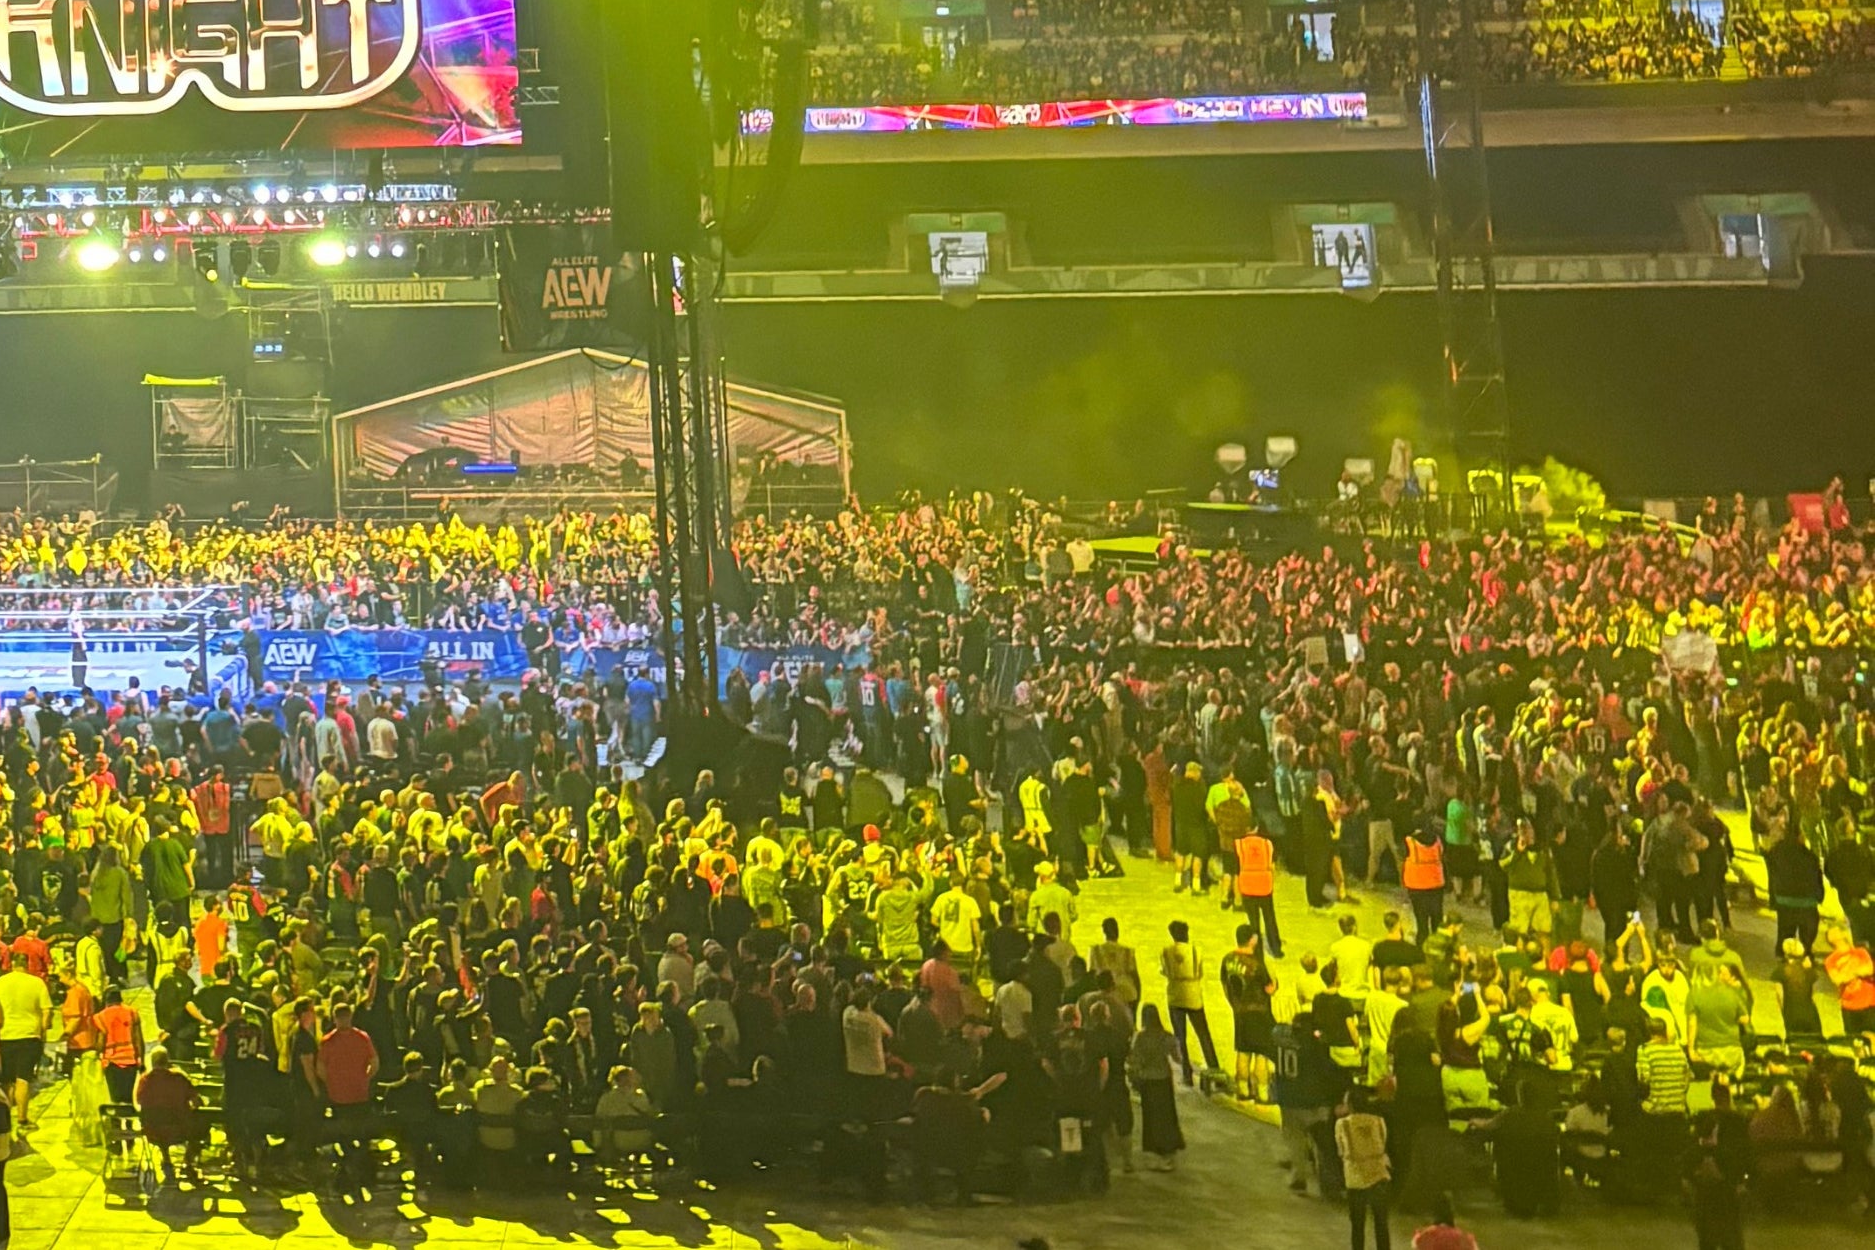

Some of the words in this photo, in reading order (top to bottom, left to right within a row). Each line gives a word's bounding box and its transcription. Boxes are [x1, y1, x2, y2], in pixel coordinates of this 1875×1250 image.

[551, 257, 571, 266] ALL
[572, 256, 598, 265] ELITE
[333, 283, 375, 301] HELLO
[378, 282, 446, 300] WEMBLEY
[542, 267, 612, 308] AEW
[264, 643, 317, 665] AEW
[426, 641, 467, 660] ALL
[471, 641, 494, 660] IN
[848, 880, 868, 900] 23
[232, 901, 249, 922] 10
[1277, 1046, 1298, 1077] 10
